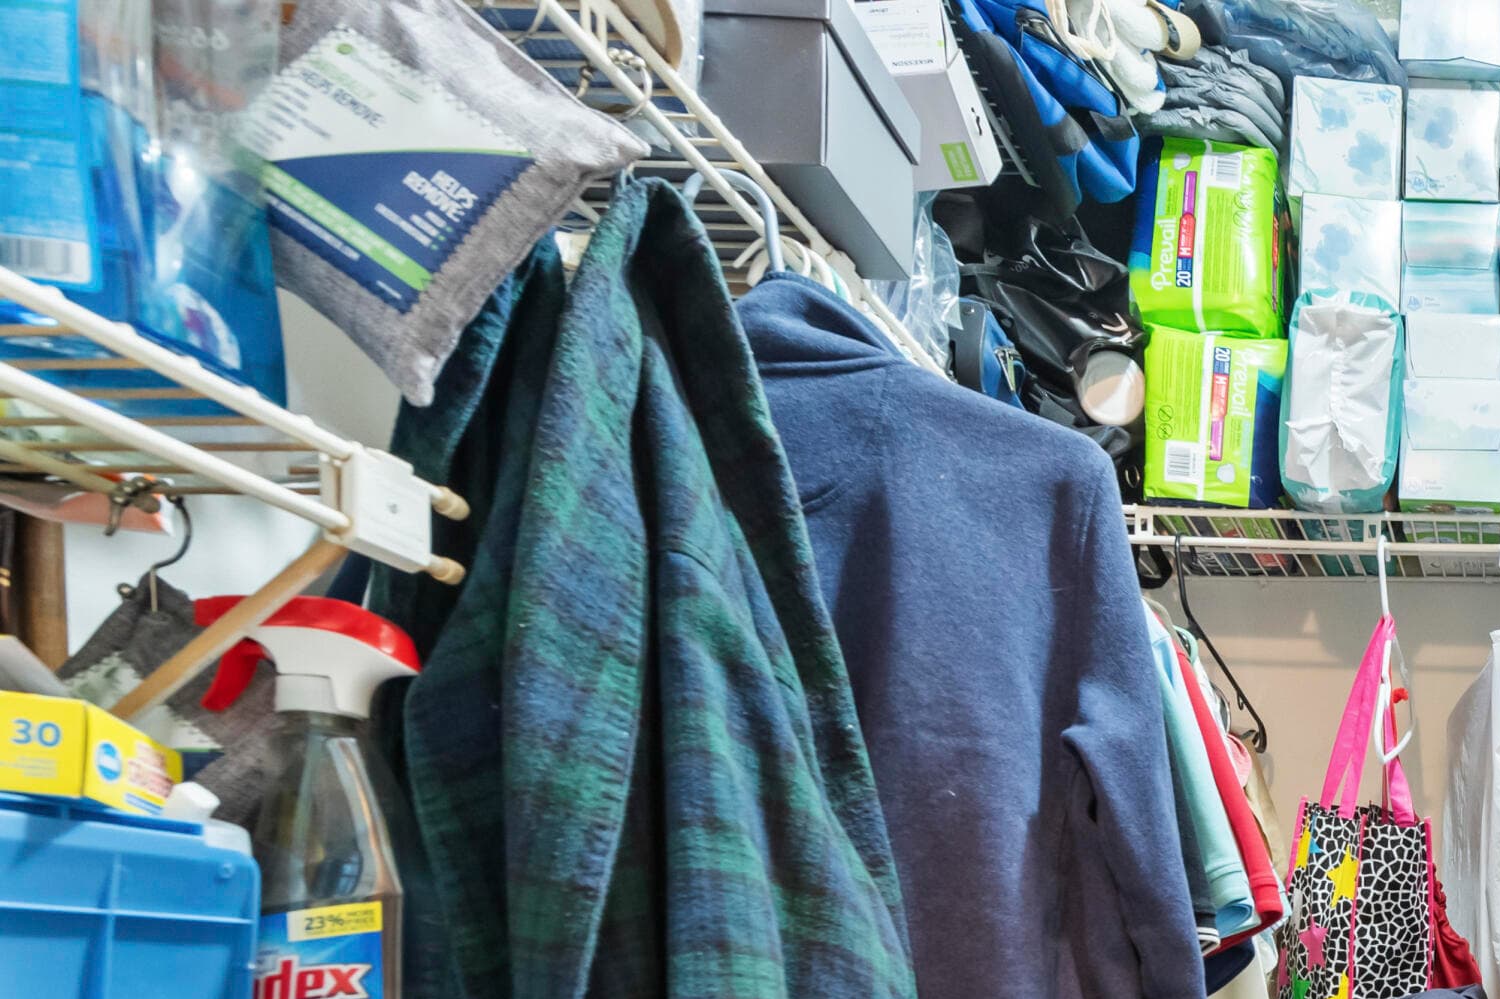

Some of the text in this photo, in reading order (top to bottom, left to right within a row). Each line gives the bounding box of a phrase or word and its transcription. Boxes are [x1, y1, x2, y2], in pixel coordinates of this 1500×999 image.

[1151, 217, 1177, 291] Prevail
[1176, 271, 1192, 286] 20
[1215, 347, 1231, 362] 20
[11, 718, 62, 747] 30
[304, 913, 345, 931] 23%
